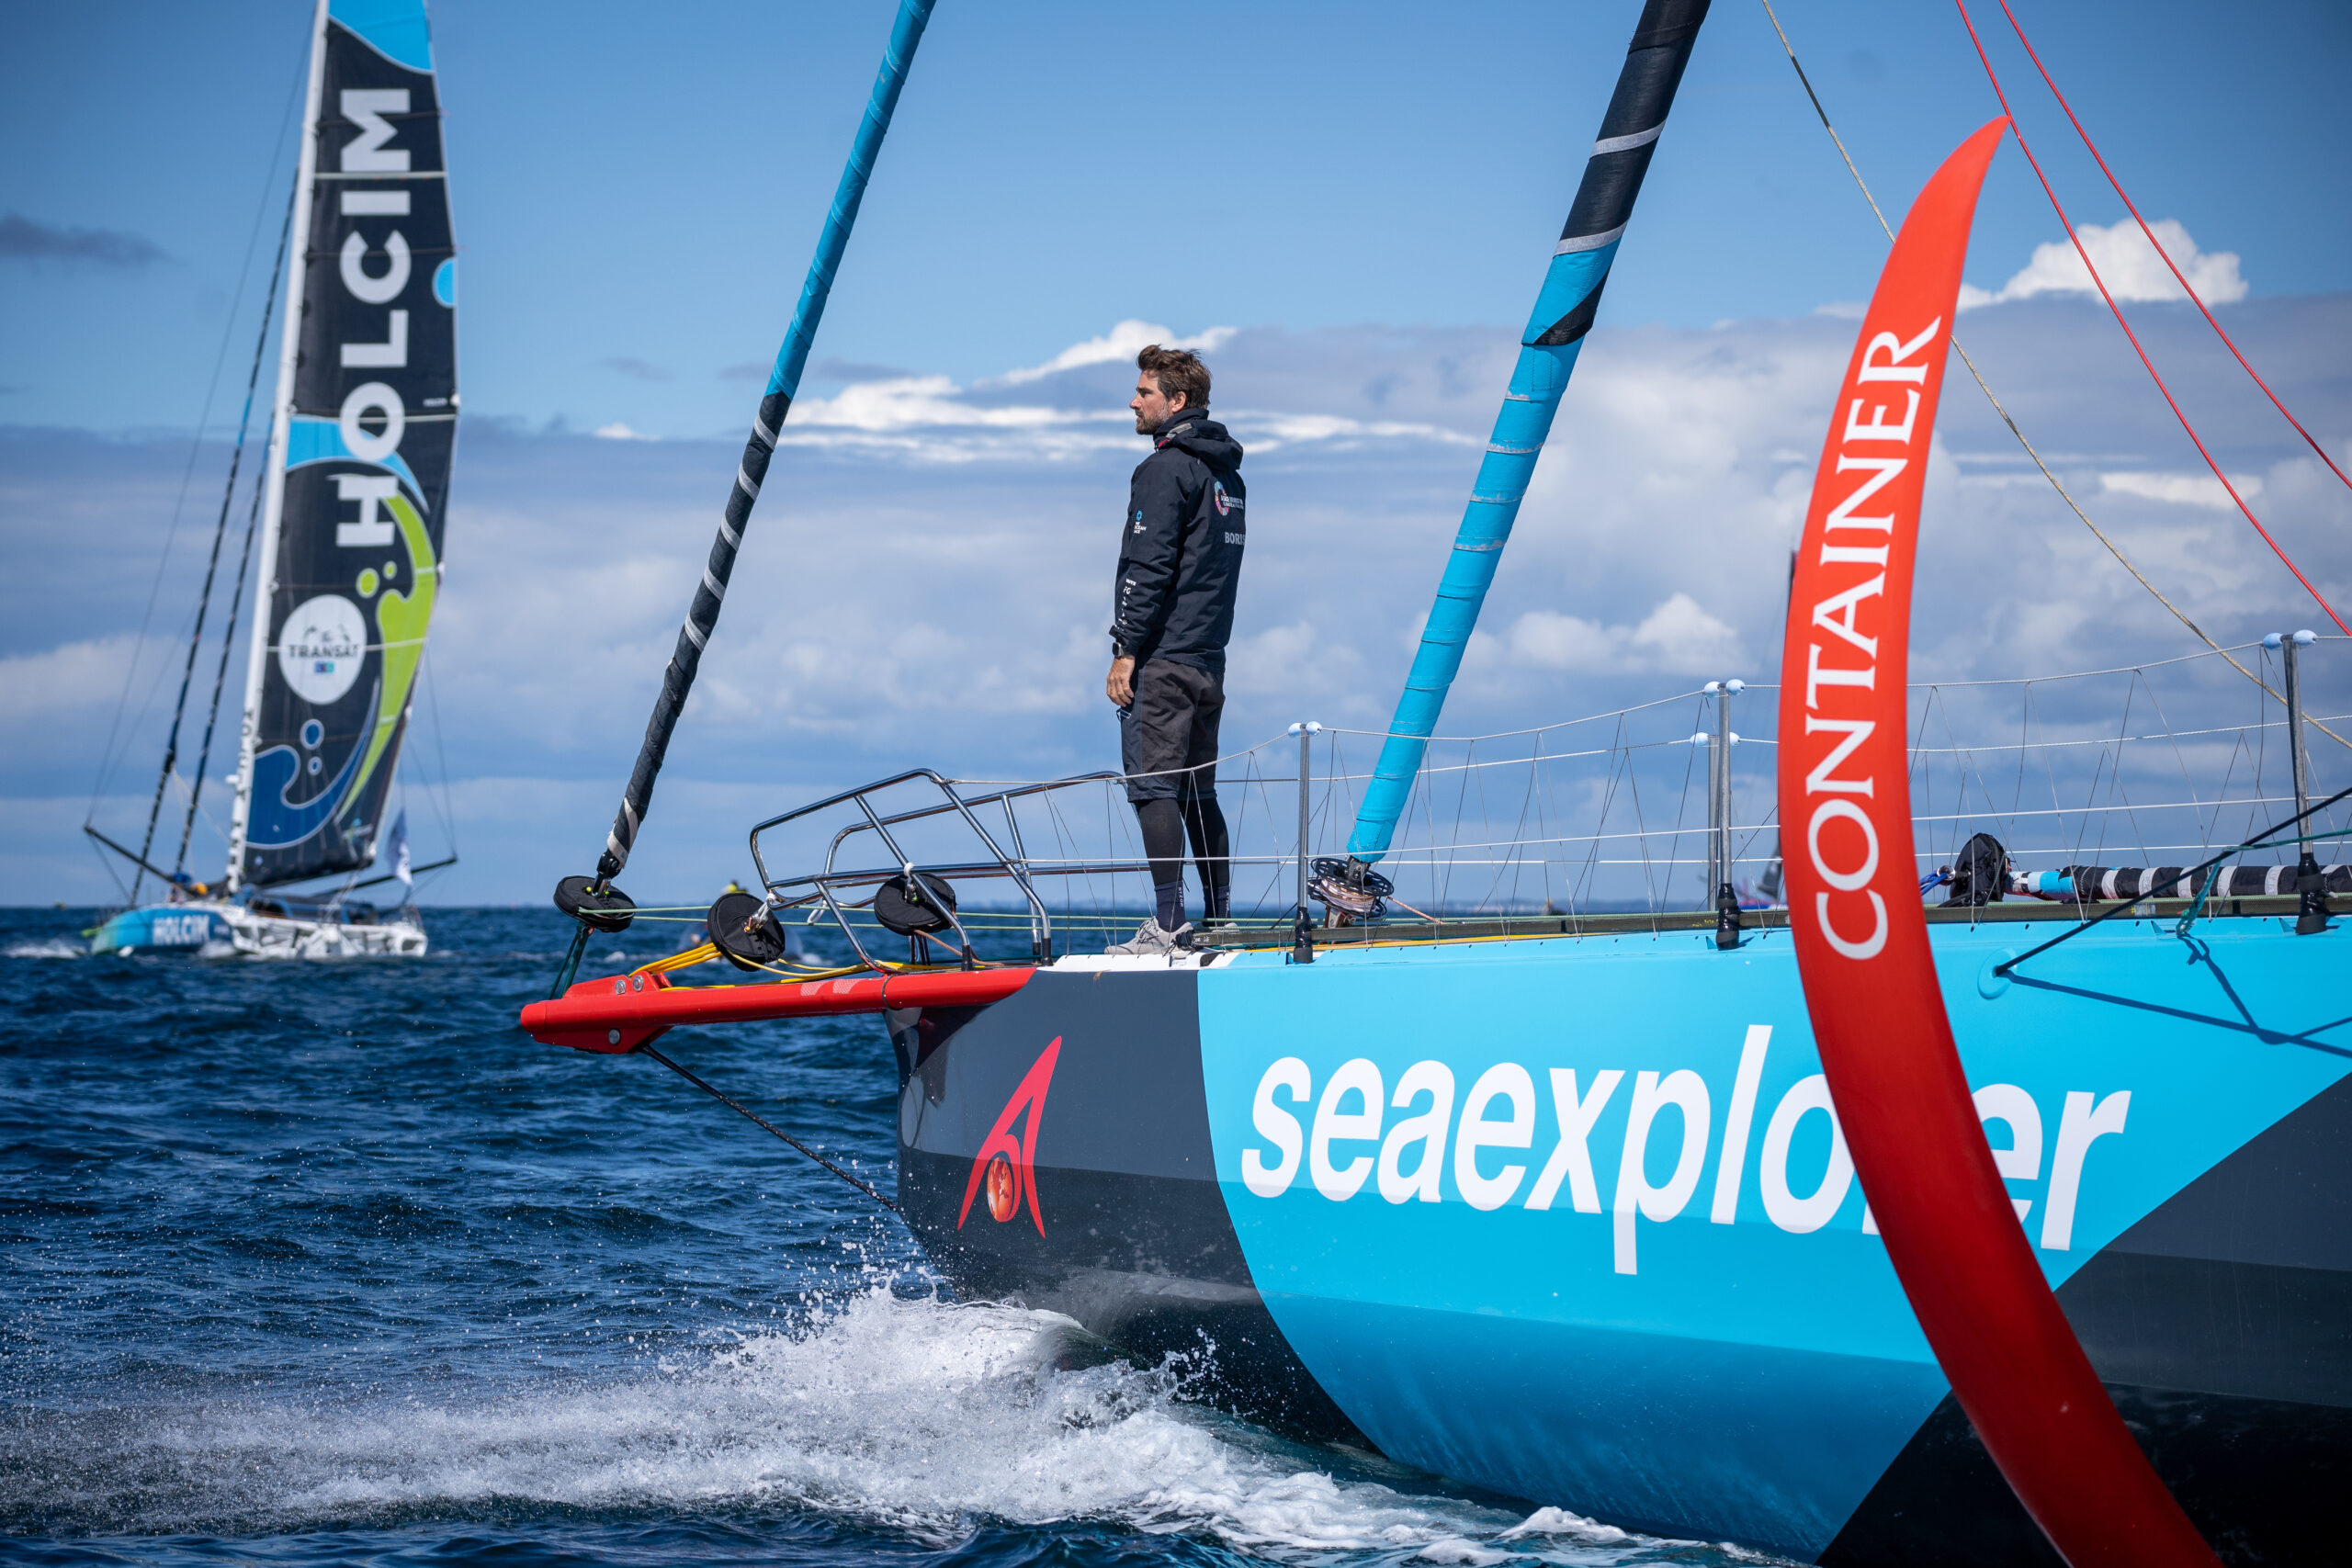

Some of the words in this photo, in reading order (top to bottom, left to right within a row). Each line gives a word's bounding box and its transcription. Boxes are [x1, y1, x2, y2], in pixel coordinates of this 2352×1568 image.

[336, 89, 411, 547] HOLCIM
[288, 644, 359, 658] TRANSAT
[1806, 316, 1941, 960] CONTAINER
[1241, 1024, 2132, 1274] seaexploer
